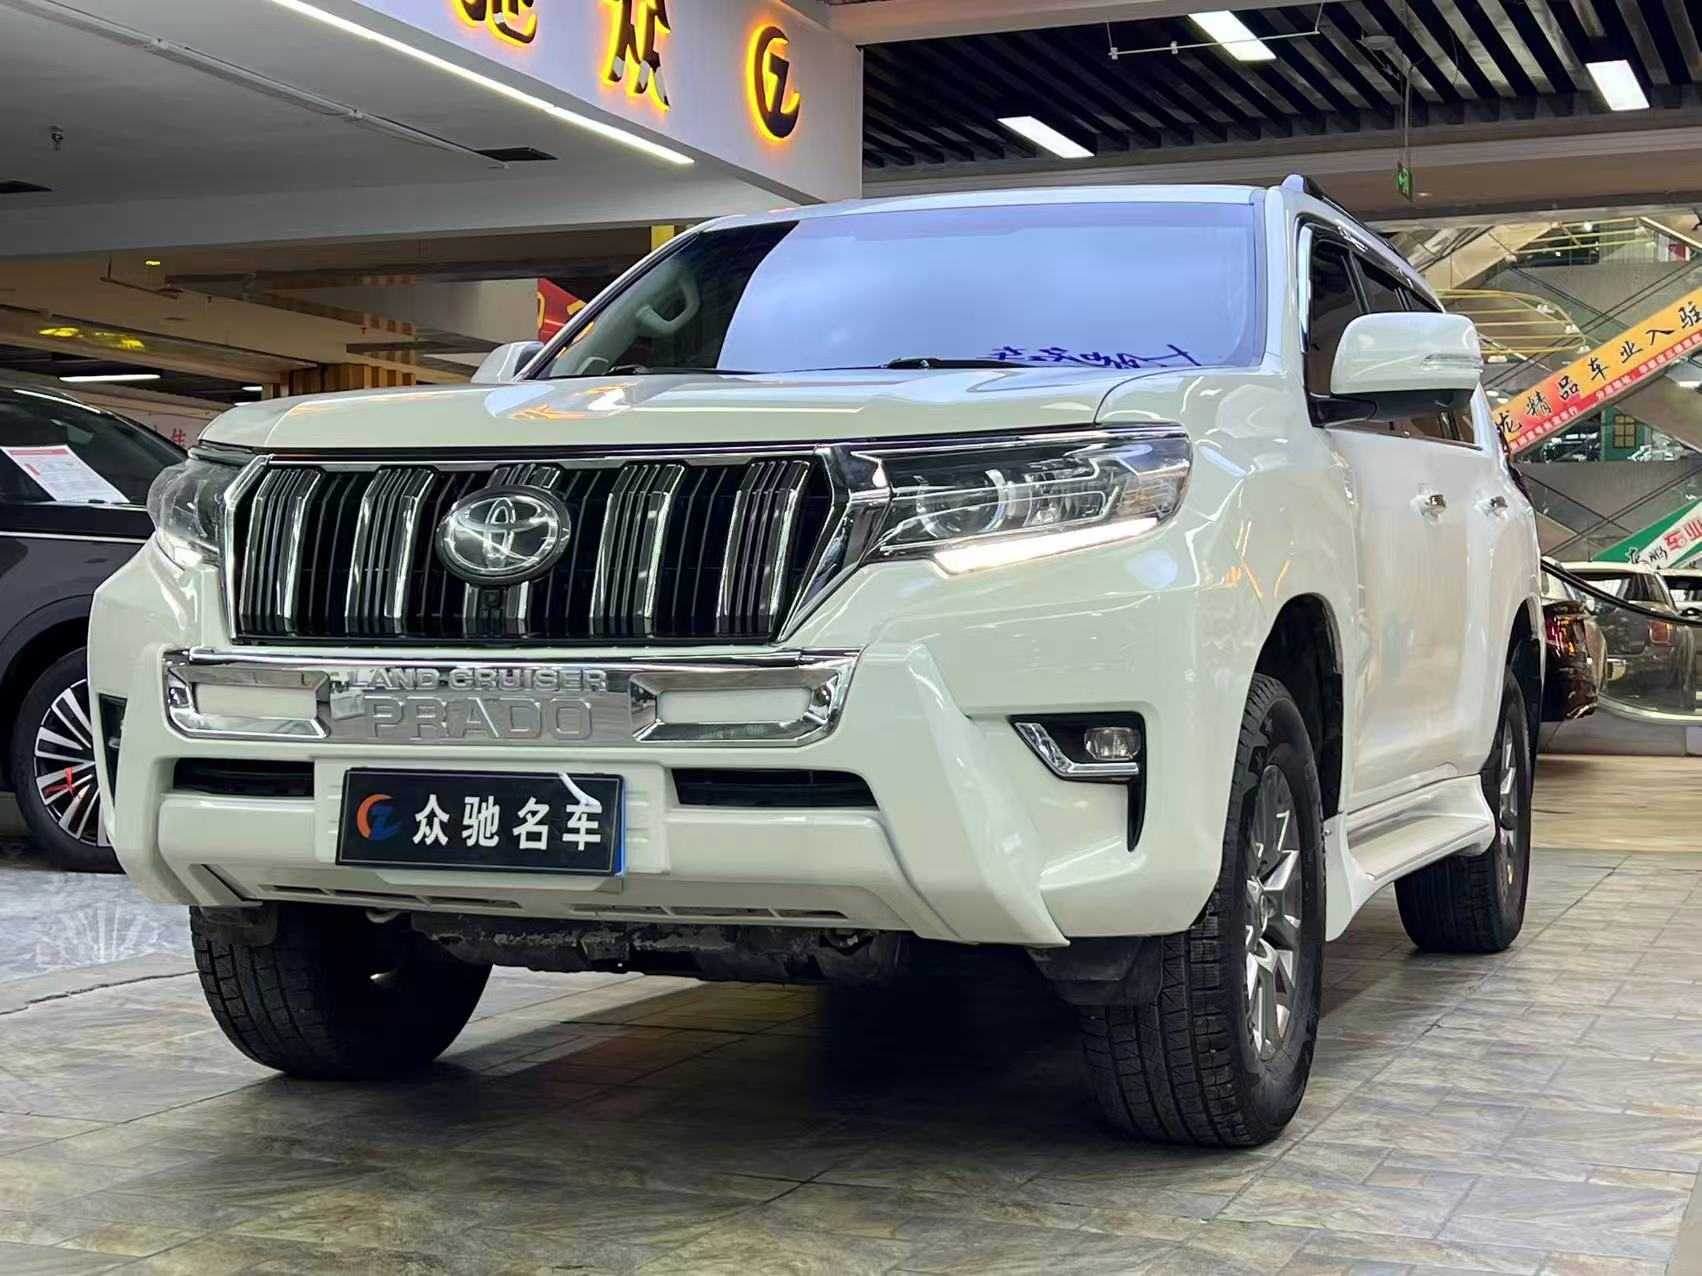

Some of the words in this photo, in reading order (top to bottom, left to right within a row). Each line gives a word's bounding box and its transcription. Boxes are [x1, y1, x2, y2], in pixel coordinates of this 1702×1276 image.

[350, 667, 441, 691] LAND
[449, 668, 608, 693] CRUISER
[364, 696, 593, 740] PRADO
[412, 793, 602, 851] 众驰名车
